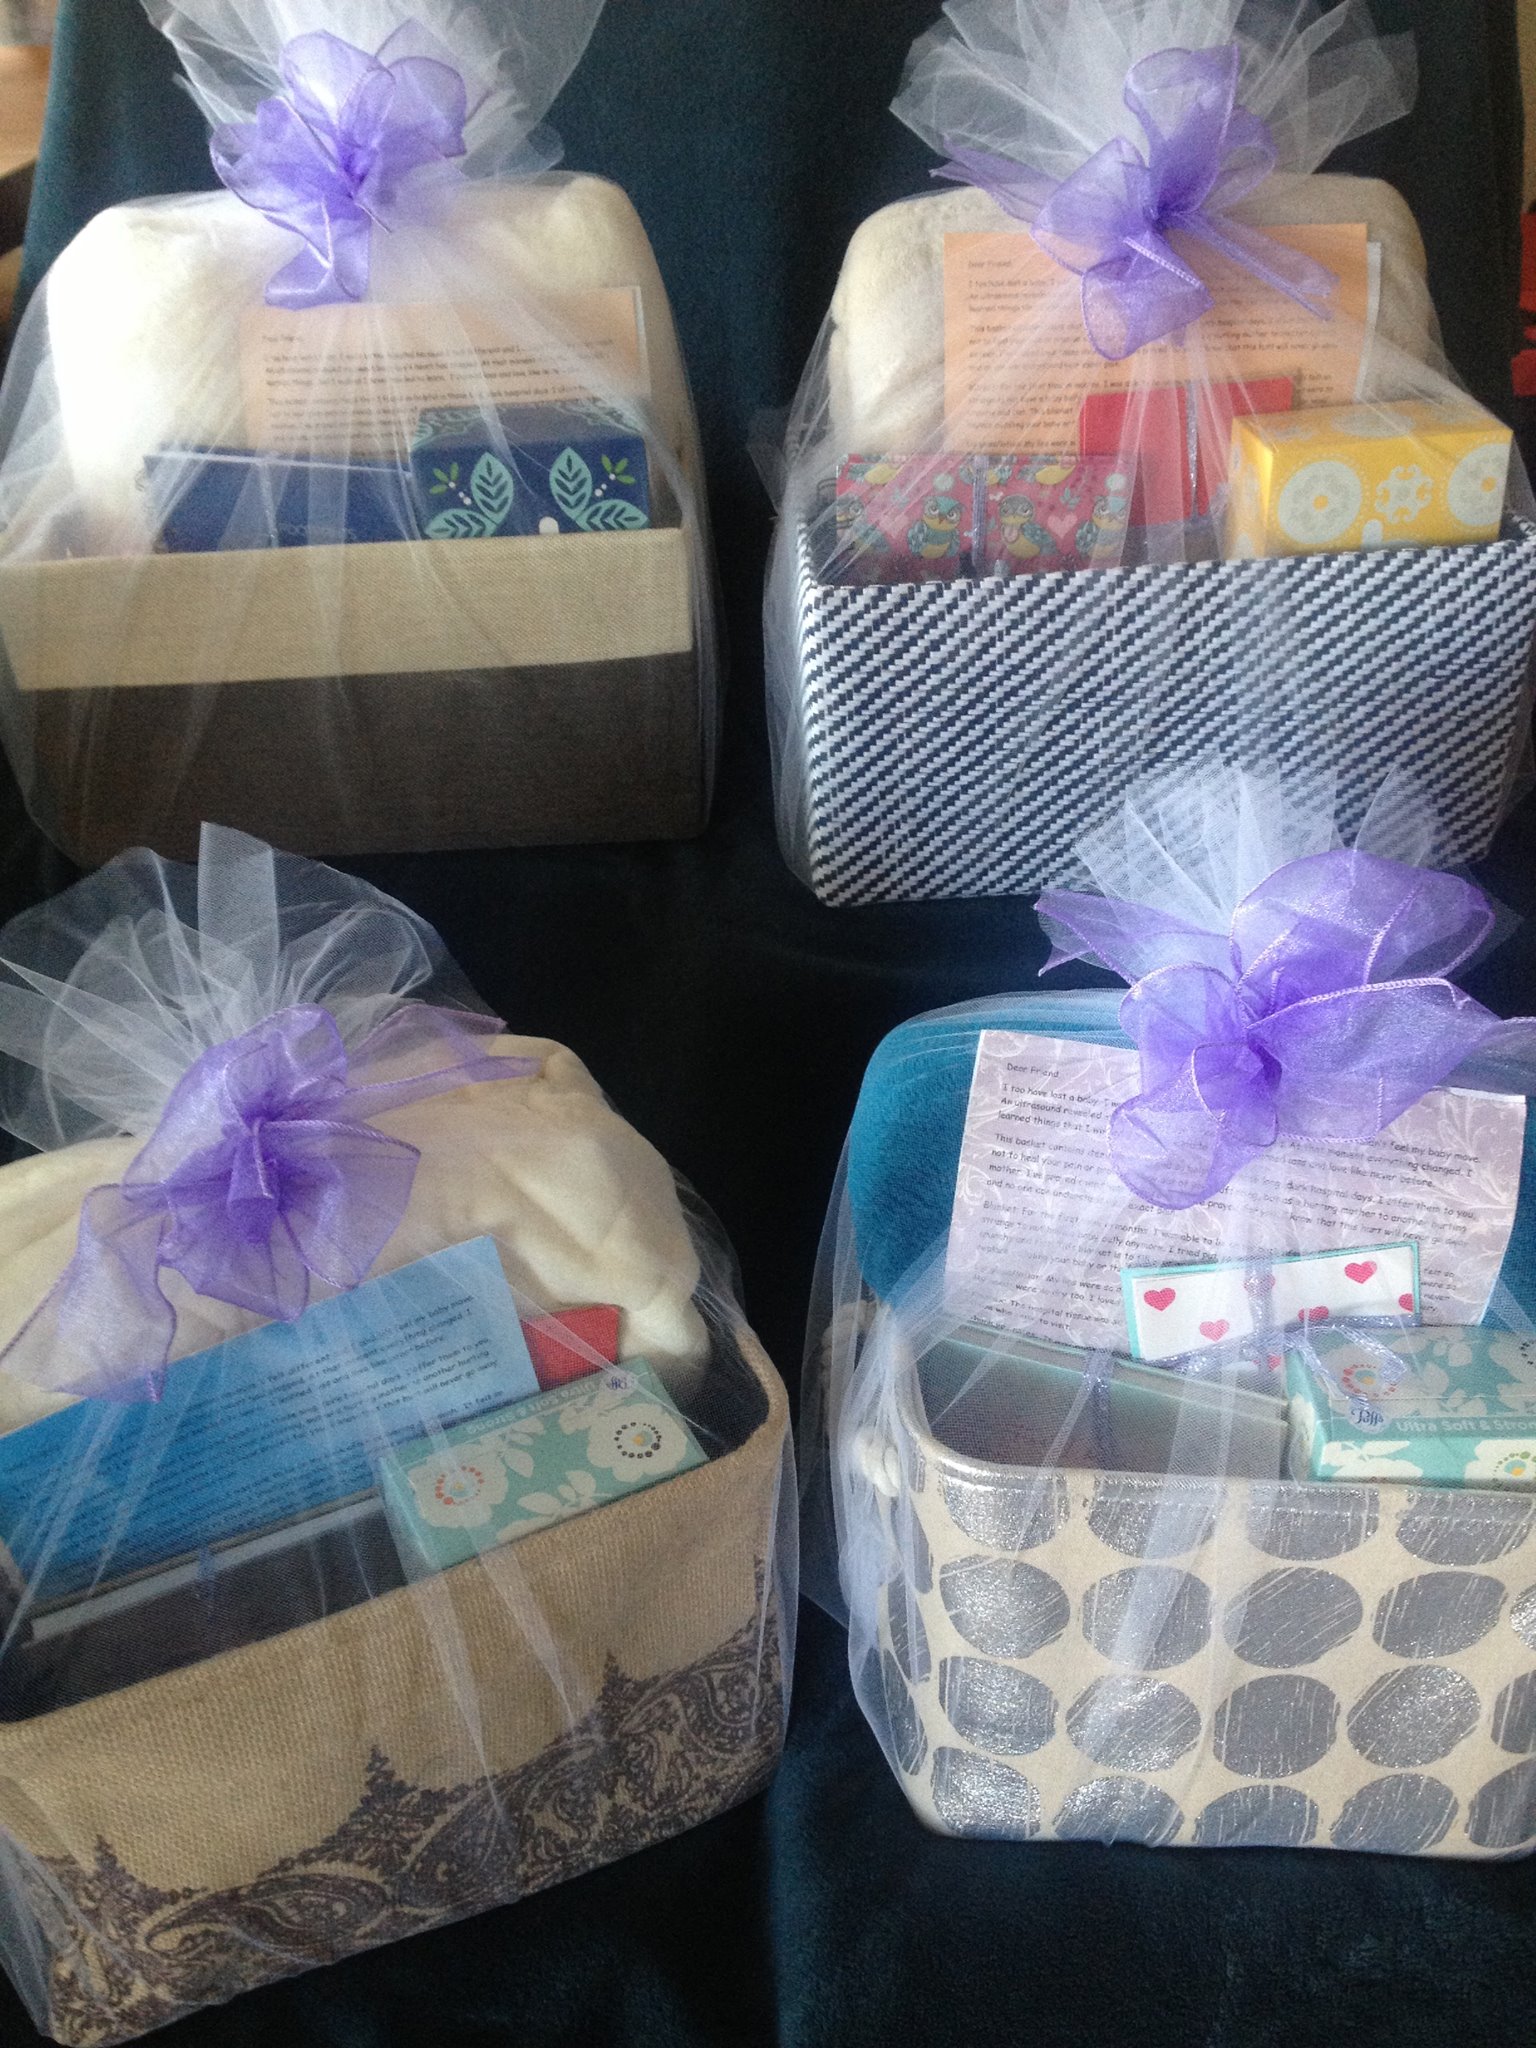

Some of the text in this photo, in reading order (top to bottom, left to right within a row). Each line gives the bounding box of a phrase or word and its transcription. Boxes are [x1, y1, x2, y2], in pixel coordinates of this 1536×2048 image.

[1007, 1062, 1027, 1073] Dear
[1003, 1083, 1008, 1092] I
[1011, 1086, 1026, 1094] too
[1028, 1087, 1048, 1098] have
[1051, 1091, 1067, 1100] lost
[1391, 1140, 1409, 1152] feel
[1411, 1146, 1425, 1155] my
[1428, 1147, 1452, 1160] baby
[1000, 1097, 1012, 1105] An
[1015, 1099, 1062, 1113] ultrasound
[1327, 1148, 1364, 1159] moment
[1367, 1154, 1420, 1171] everything
[1466, 1168, 1473, 1178] I
[998, 1110, 1031, 1123] learned
[1034, 1117, 1061, 1129] things
[1328, 1163, 1348, 1174] love
[1350, 1166, 1367, 1176] like
[1370, 1171, 1395, 1180] never
[995, 1133, 1013, 1144] This
[1015, 1138, 1046, 1149] basket
[1311, 1184, 1347, 1198] hospital
[1416, 1202, 1441, 1213] them
[1444, 1207, 1453, 1216] to
[986, 1179, 1003, 1188] and
[1005, 1182, 1015, 1191] no
[991, 1149, 1007, 1158] not
[1009, 1150, 1018, 1160] to
[1021, 1153, 1040, 1163] heal
[1042, 1159, 1061, 1169] your
[1064, 1161, 1084, 1171] pain
[1085, 1164, 1095, 1172] or
[1341, 1207, 1377, 1218] mother
[1378, 1212, 1389, 1220] to
[1317, 1218, 1336, 1227] that
[1181, 1234, 1200, 1245] able
[1203, 1237, 1213, 1246] to
[1124, 1252, 1135, 1261] to
[1175, 1247, 1200, 1260] tried
[1015, 1283, 1038, 1294] were
[1080, 1280, 1102, 1290] were
[428, 1305, 449, 1318] baby
[439, 1349, 461, 1362] them
[423, 1363, 456, 1381] another
[457, 1350, 490, 1368] hurting
[440, 1374, 463, 1387] never
[1396, 1421, 1536, 1433] Ultra Soft & Stron
